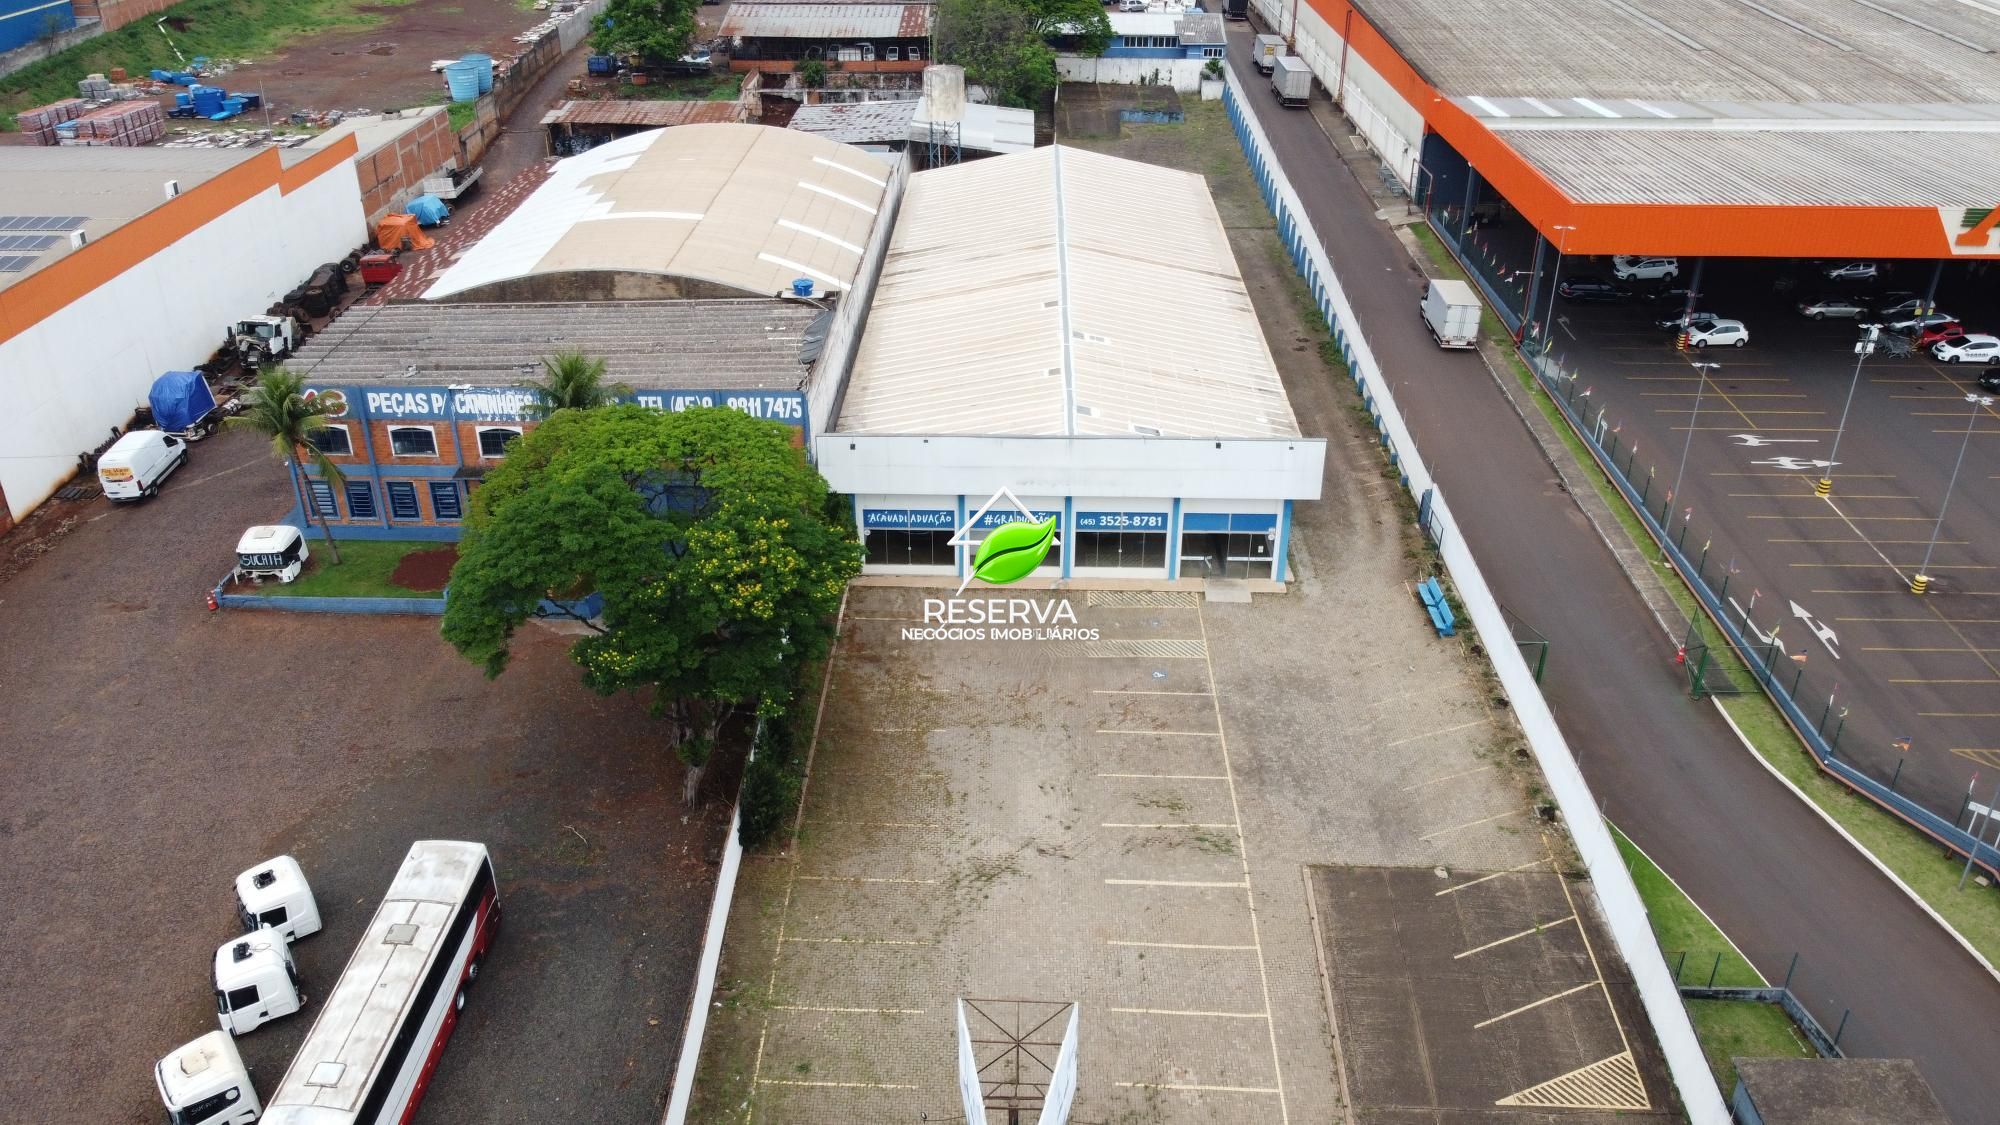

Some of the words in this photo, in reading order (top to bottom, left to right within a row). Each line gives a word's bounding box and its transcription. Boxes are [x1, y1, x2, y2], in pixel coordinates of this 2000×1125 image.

[367, 392, 429, 417] PEÇAS
[431, 392, 447, 416] P/
[764, 397, 802, 419] 7475
[1080, 517, 1096, 526] (45)
[1099, 515, 1162, 527] 3525-8781
